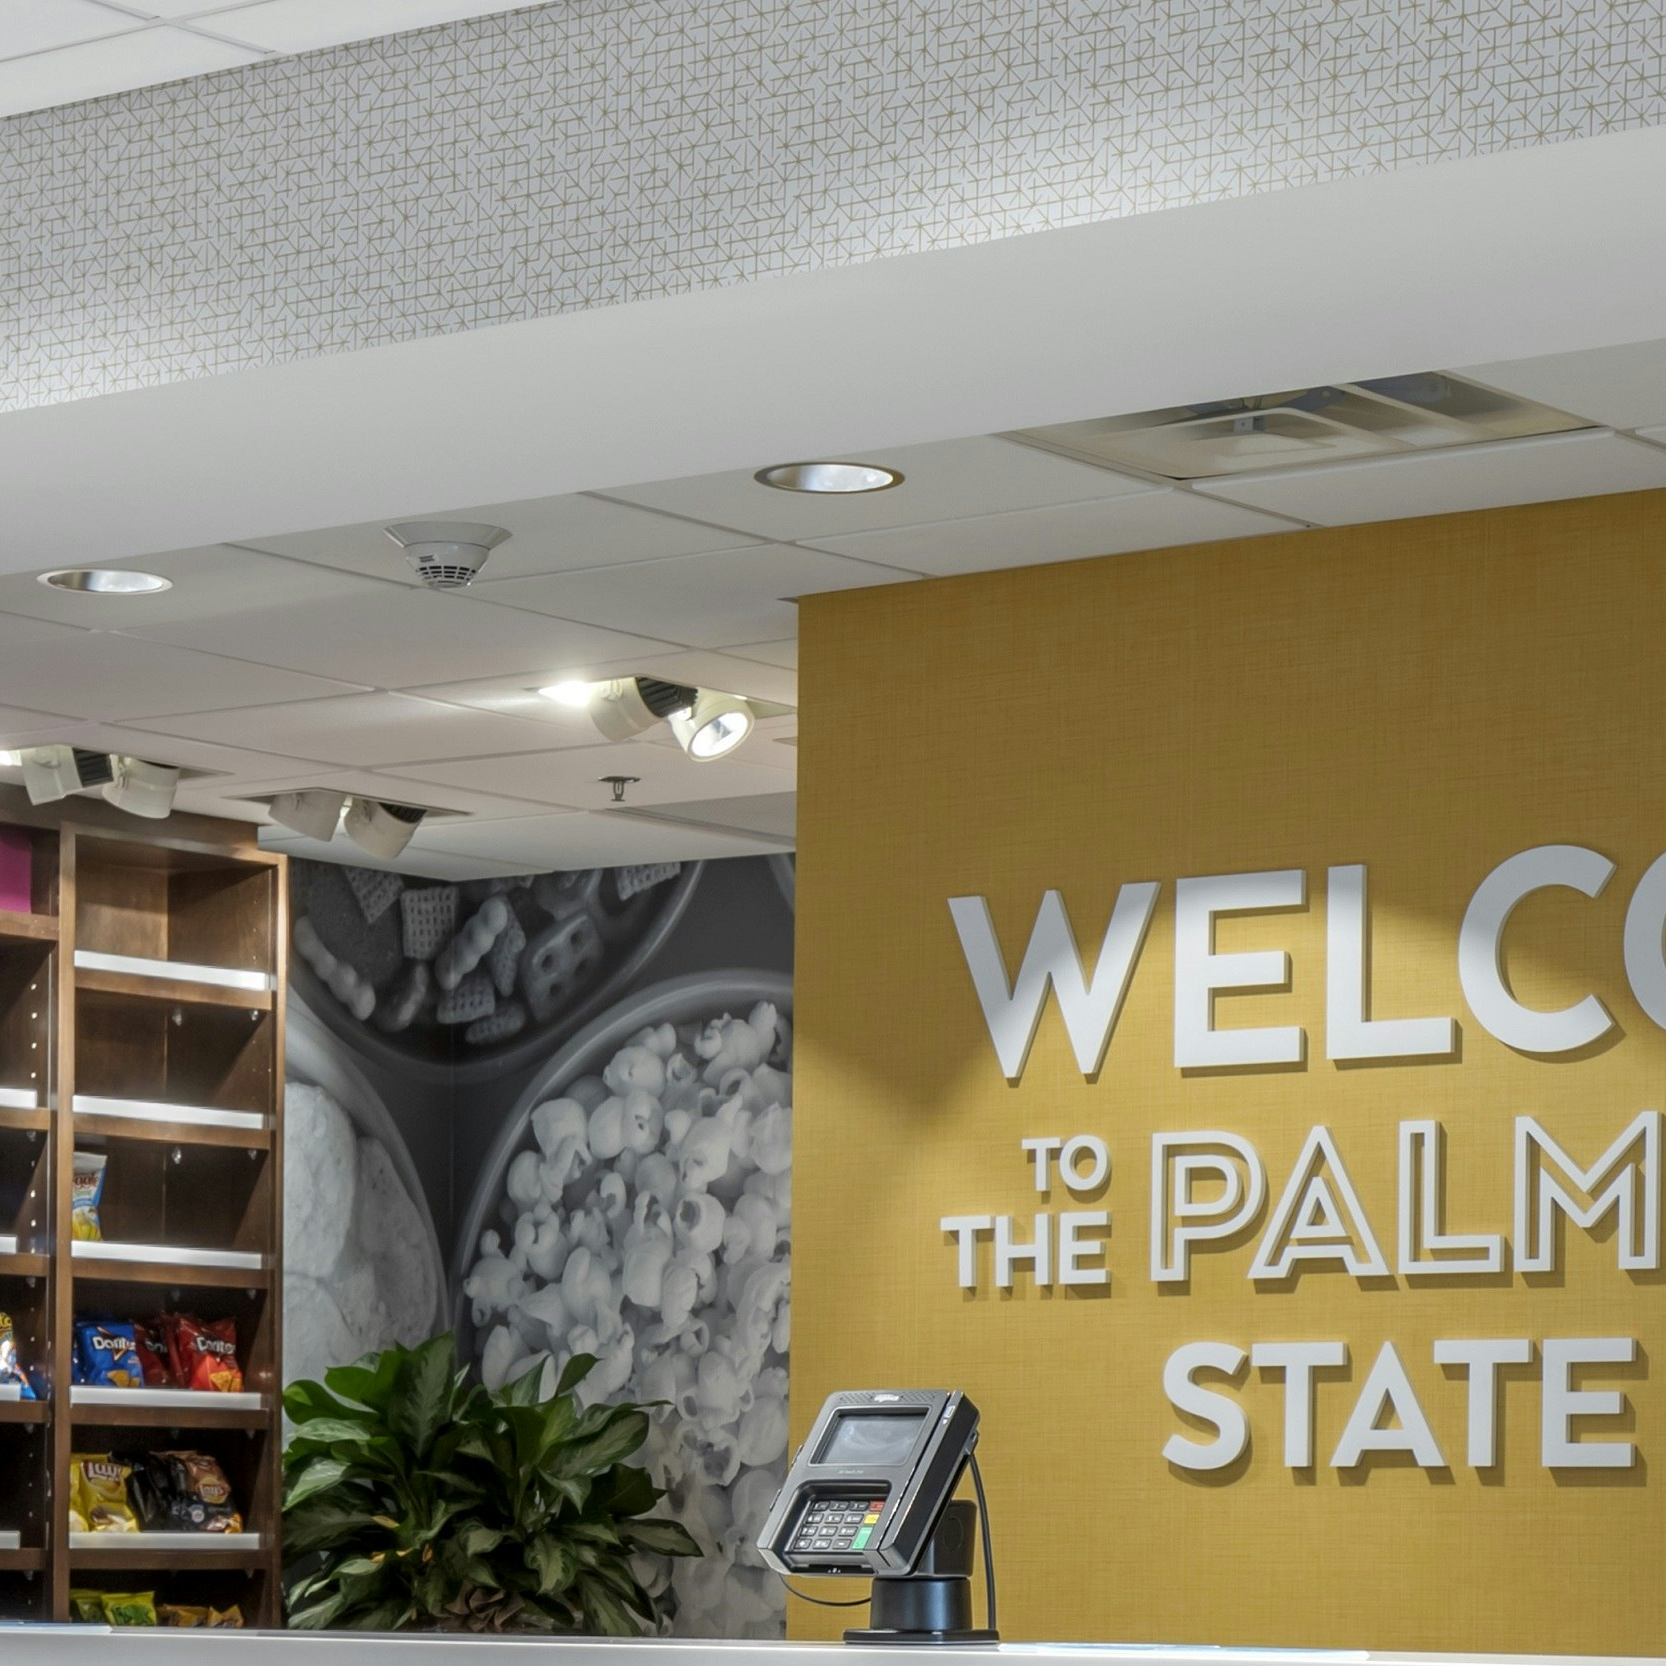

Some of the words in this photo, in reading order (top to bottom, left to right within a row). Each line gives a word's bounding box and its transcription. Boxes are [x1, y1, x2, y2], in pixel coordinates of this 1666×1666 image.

[1021, 1134, 1112, 1193] TO
[940, 1210, 1112, 1289] THE
[1161, 1336, 1637, 1471] STATE
